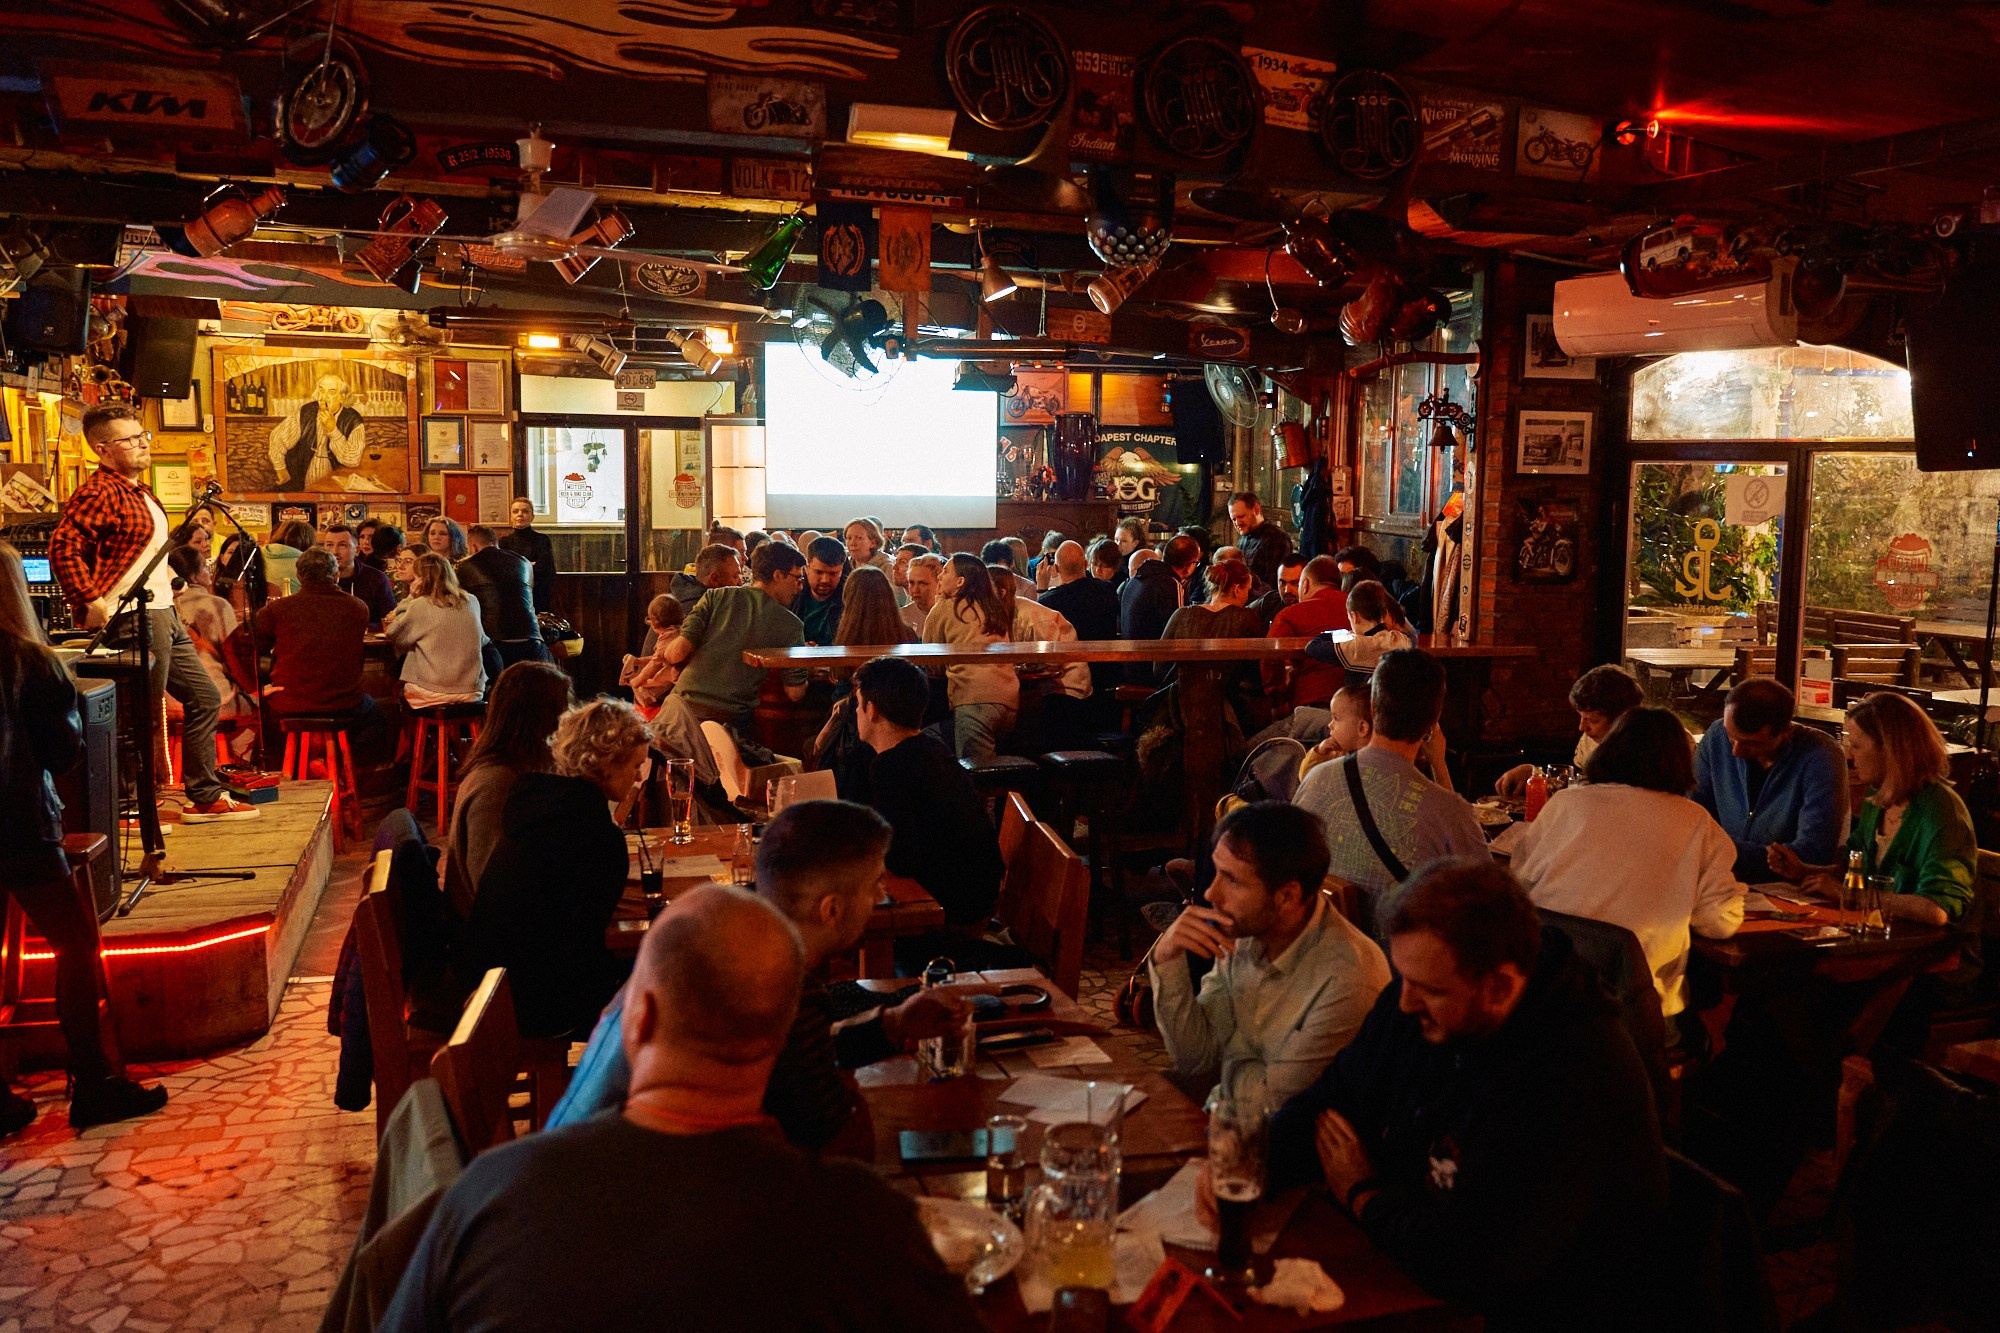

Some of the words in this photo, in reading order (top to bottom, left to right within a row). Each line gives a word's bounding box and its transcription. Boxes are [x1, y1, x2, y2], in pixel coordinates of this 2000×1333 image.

[1258, 56, 1288, 73] 1934
[87, 89, 206, 118] KTM
[1069, 132, 1116, 151] Indian
[1450, 151, 1500, 168] MORNING
[1200, 333, 1237, 347] Vespa
[639, 375, 654, 385] 836
[1133, 433, 1177, 446] CHAPTER
